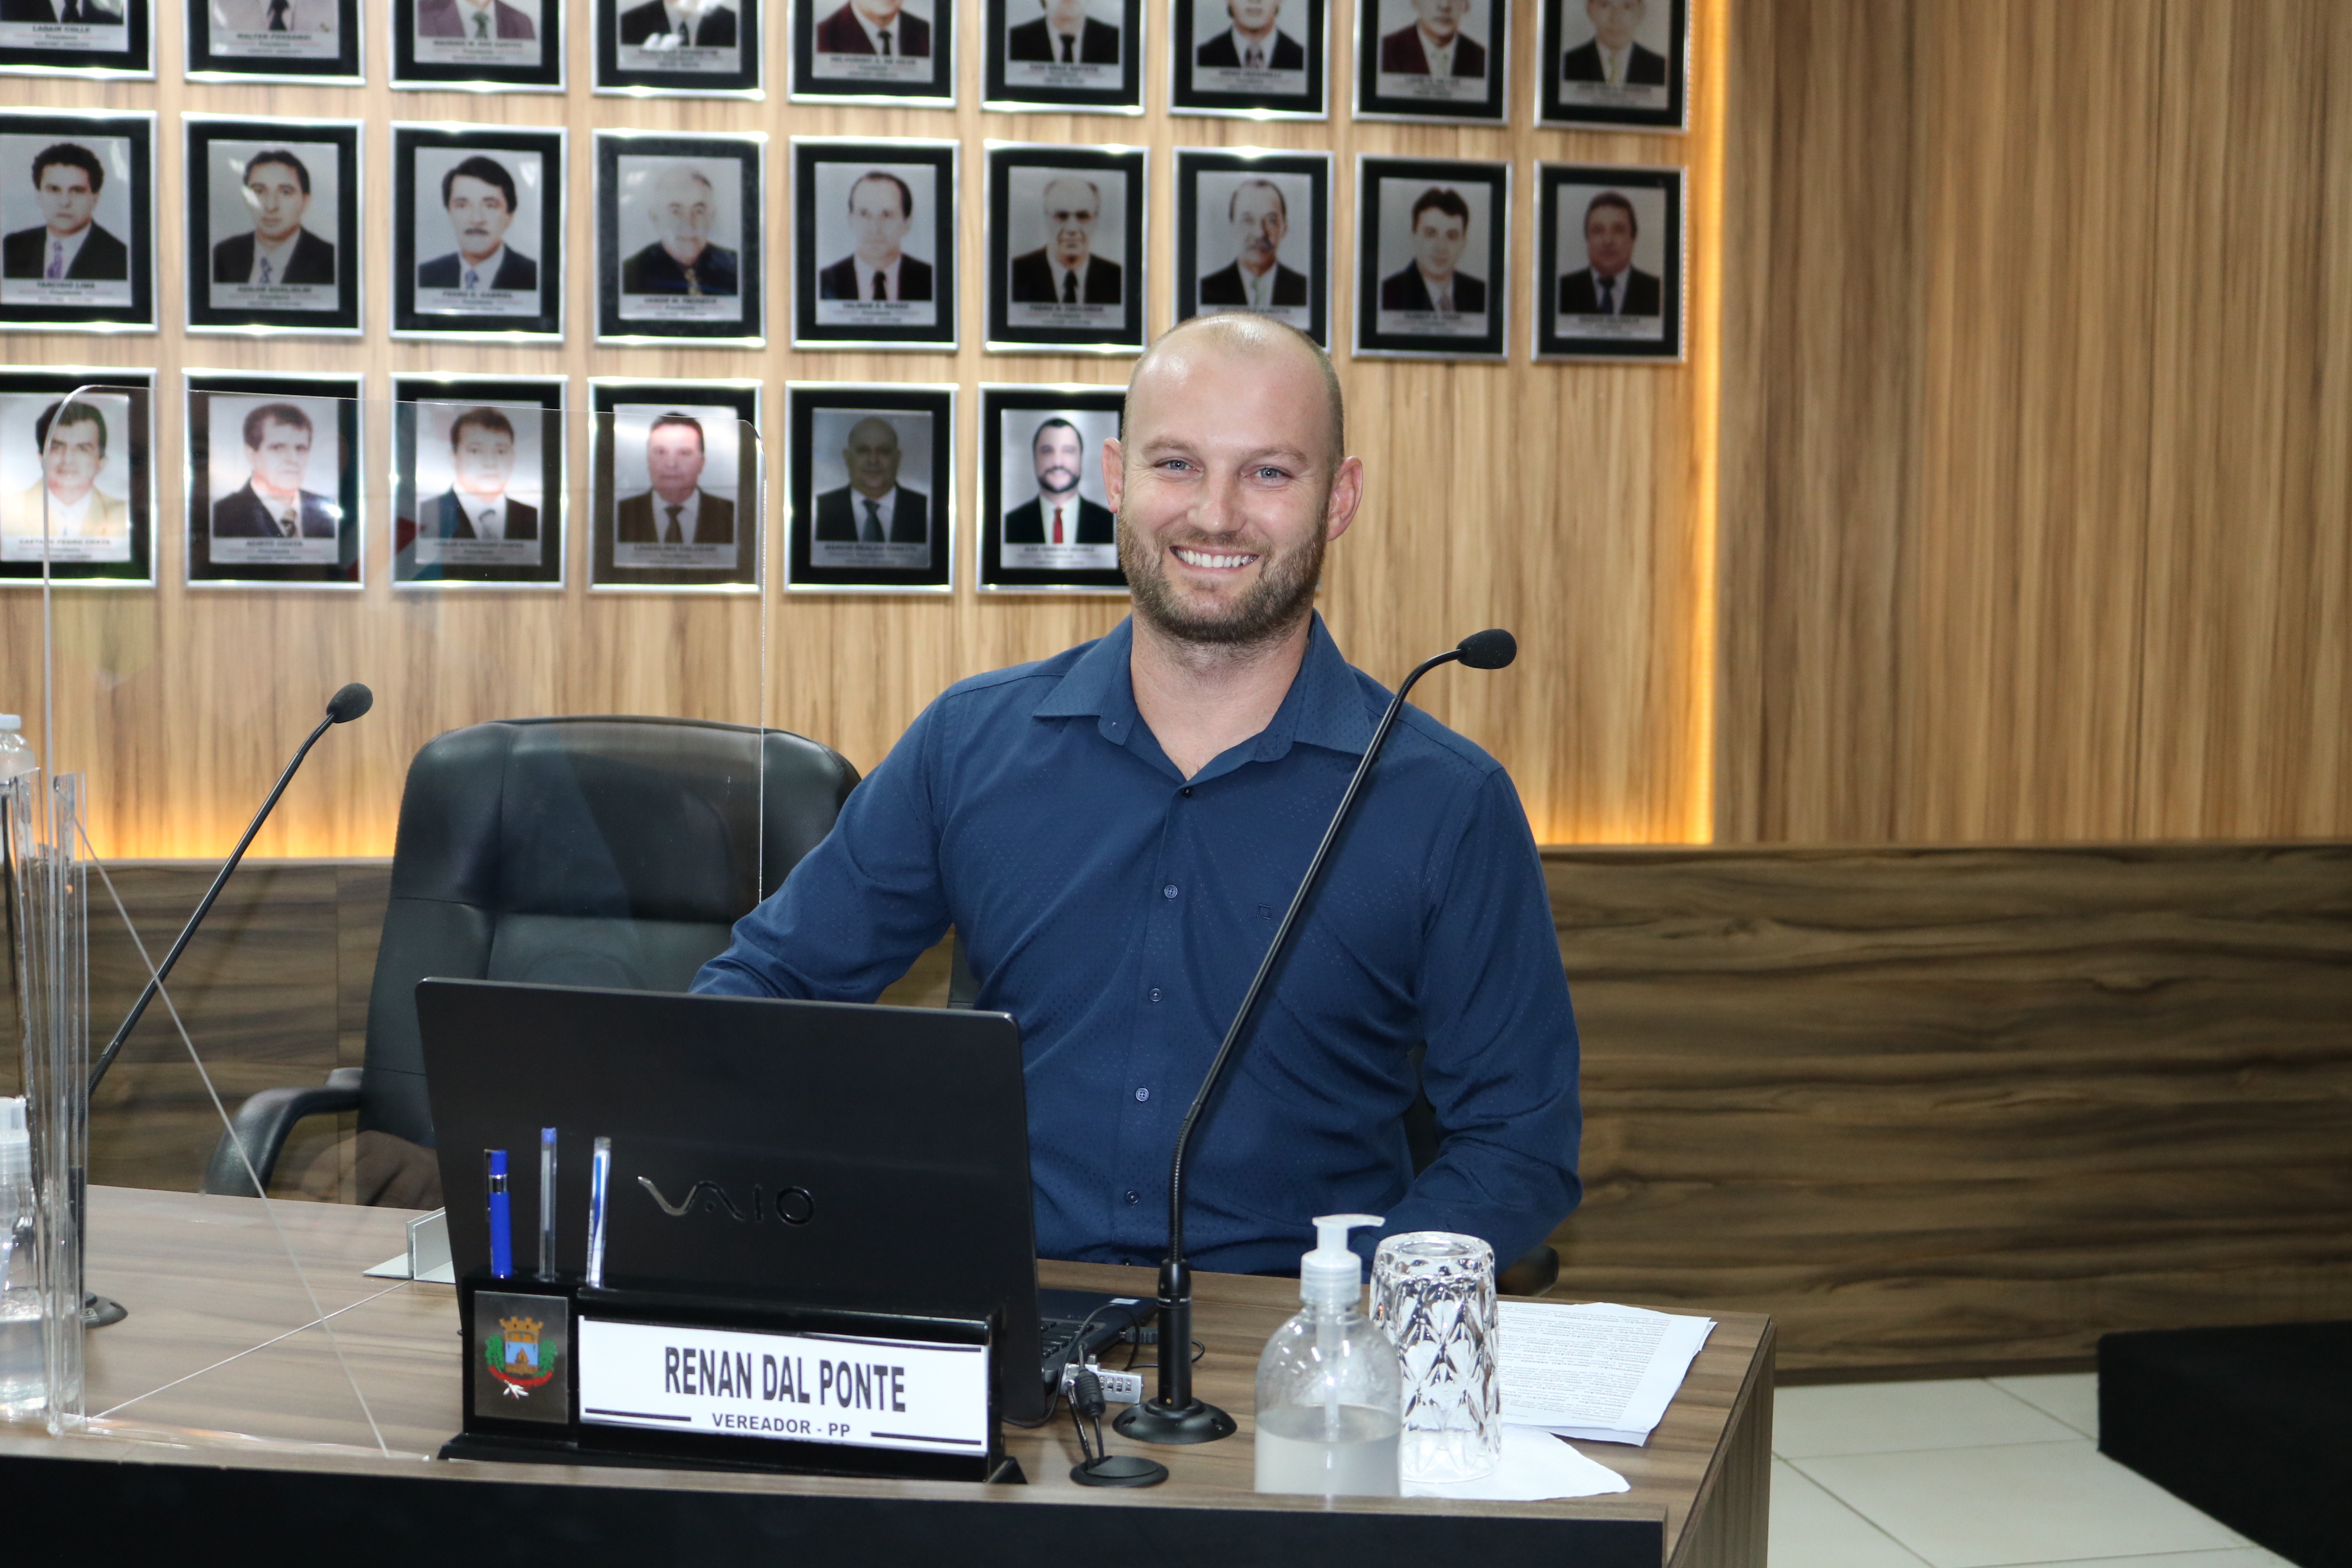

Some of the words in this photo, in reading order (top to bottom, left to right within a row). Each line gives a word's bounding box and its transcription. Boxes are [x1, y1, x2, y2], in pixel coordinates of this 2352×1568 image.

[638, 1176, 815, 1227] VAIO
[665, 1346, 752, 1399] RENAN
[762, 1354, 811, 1404] DAL
[820, 1359, 906, 1413] PONTE
[712, 1412, 811, 1434] VEREADOR
[828, 1422, 850, 1437] PP
